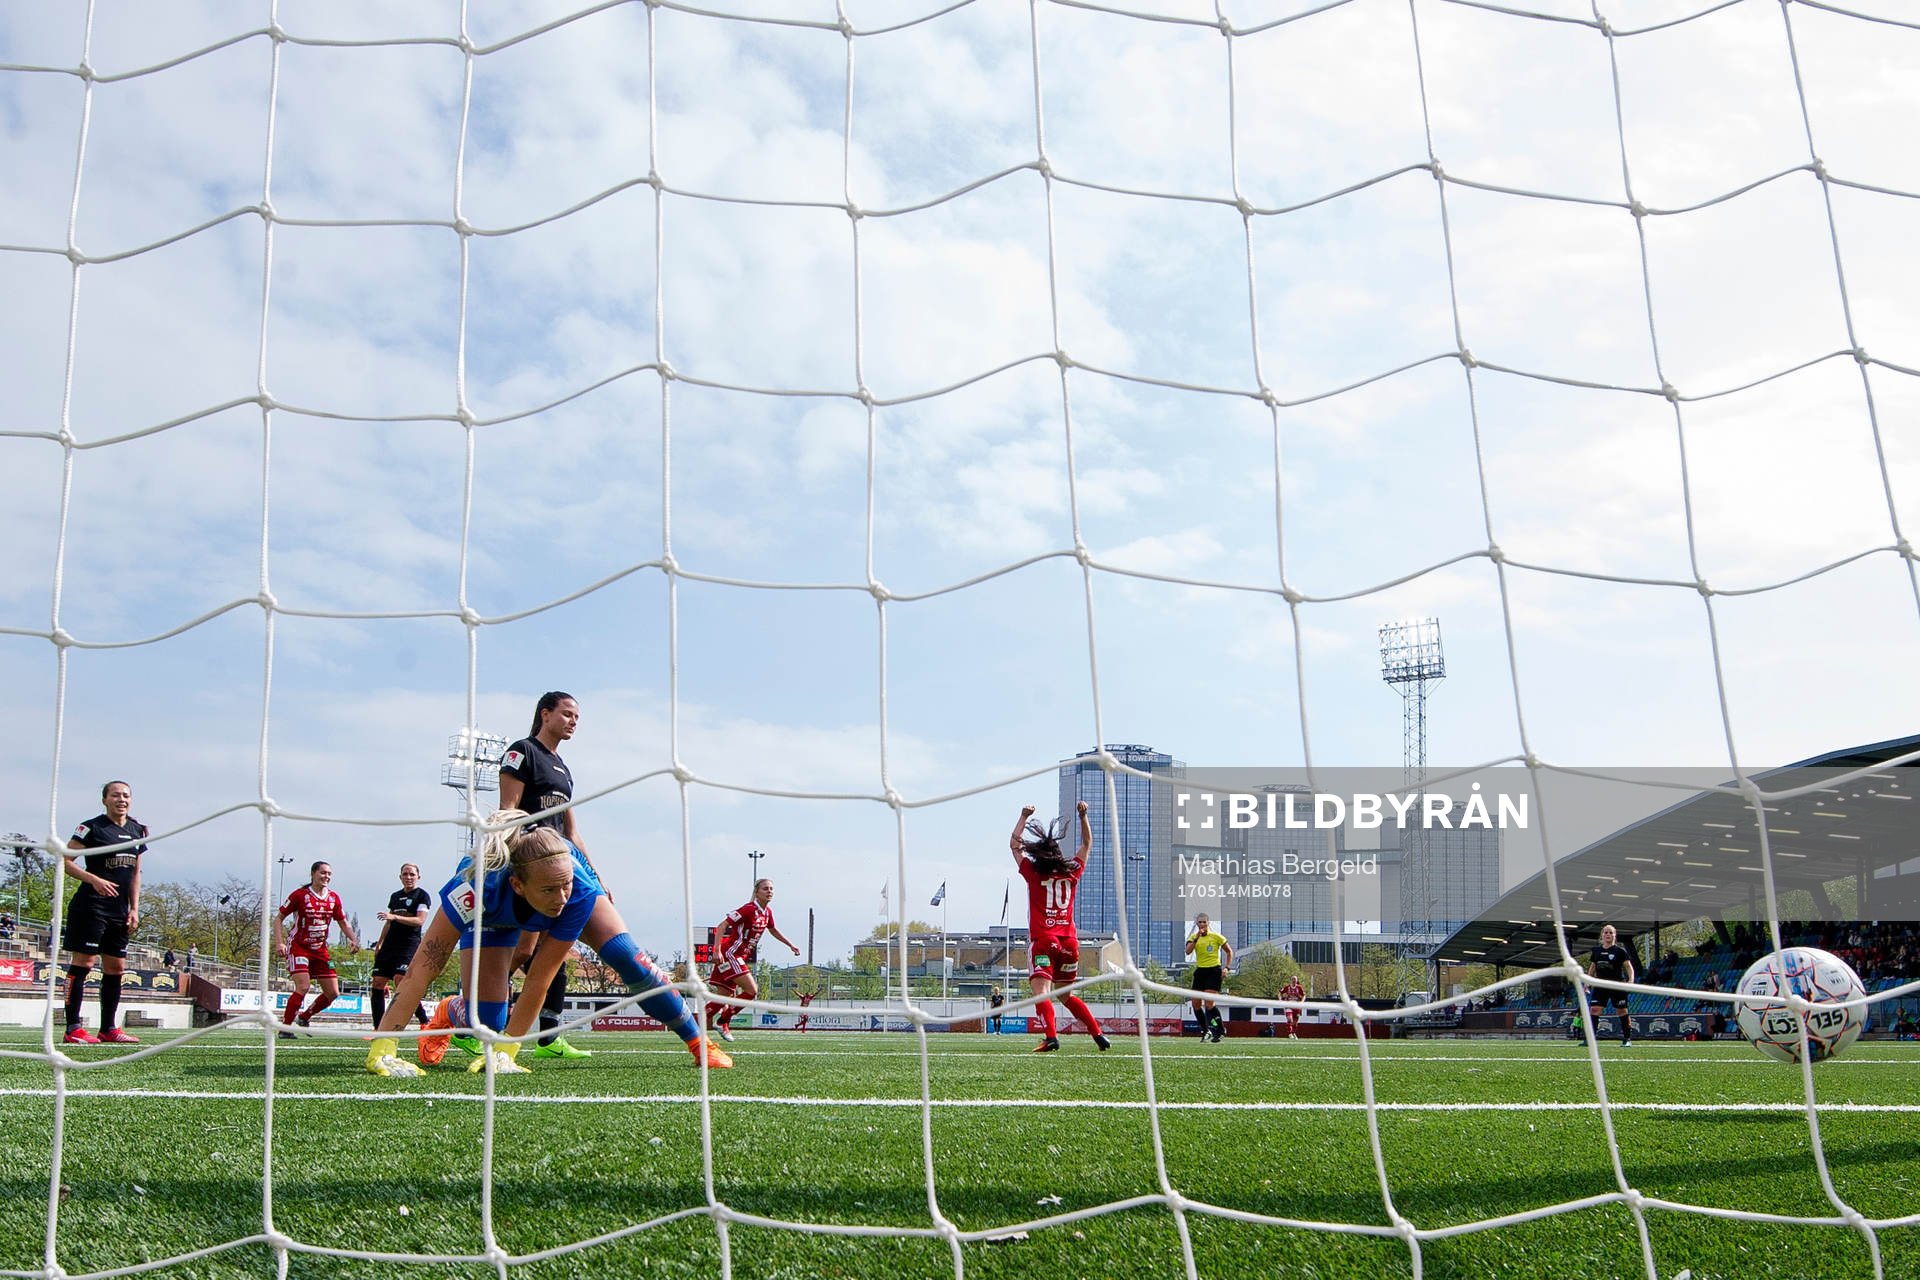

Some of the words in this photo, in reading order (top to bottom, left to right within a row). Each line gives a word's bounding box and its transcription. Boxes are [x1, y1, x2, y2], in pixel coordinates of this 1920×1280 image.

[1127, 754, 1158, 762] TOWERS
[1041, 878, 1072, 909] 10
[223, 994, 245, 1005] SKF
[608, 1018, 640, 1026] FOCUS
